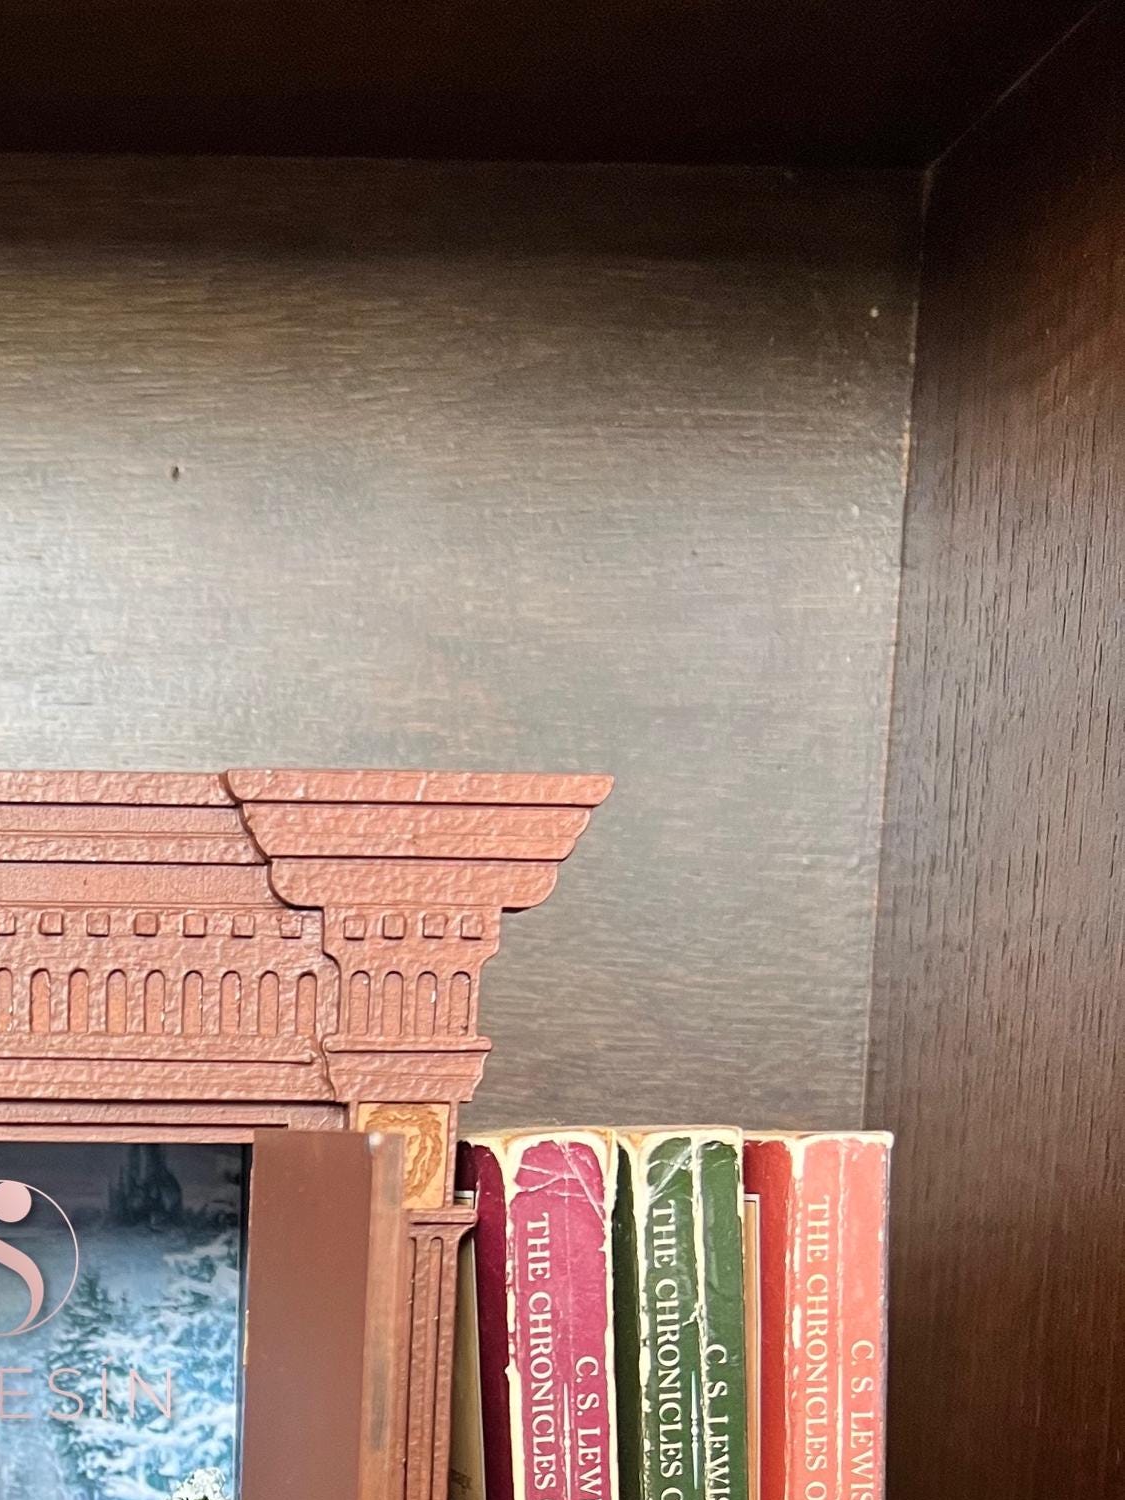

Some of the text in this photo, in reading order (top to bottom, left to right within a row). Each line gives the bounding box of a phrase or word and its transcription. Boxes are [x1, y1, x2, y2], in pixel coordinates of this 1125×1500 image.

[525, 1212, 551, 1281] THE
[651, 1199, 676, 1269] THE
[806, 1196, 830, 1264] THE
[575, 1356, 600, 1382] C.
[704, 1343, 727, 1370] C.
[804, 1274, 829, 1471] CHRONICLES
[850, 1339, 874, 1366] C.
[527, 1294, 556, 1492] CHRONICLES
[654, 1278, 683, 1478] CHRONICLES
[705, 1380, 728, 1405] S.
[851, 1376, 874, 1401] S.
[577, 1393, 599, 1417] S.
